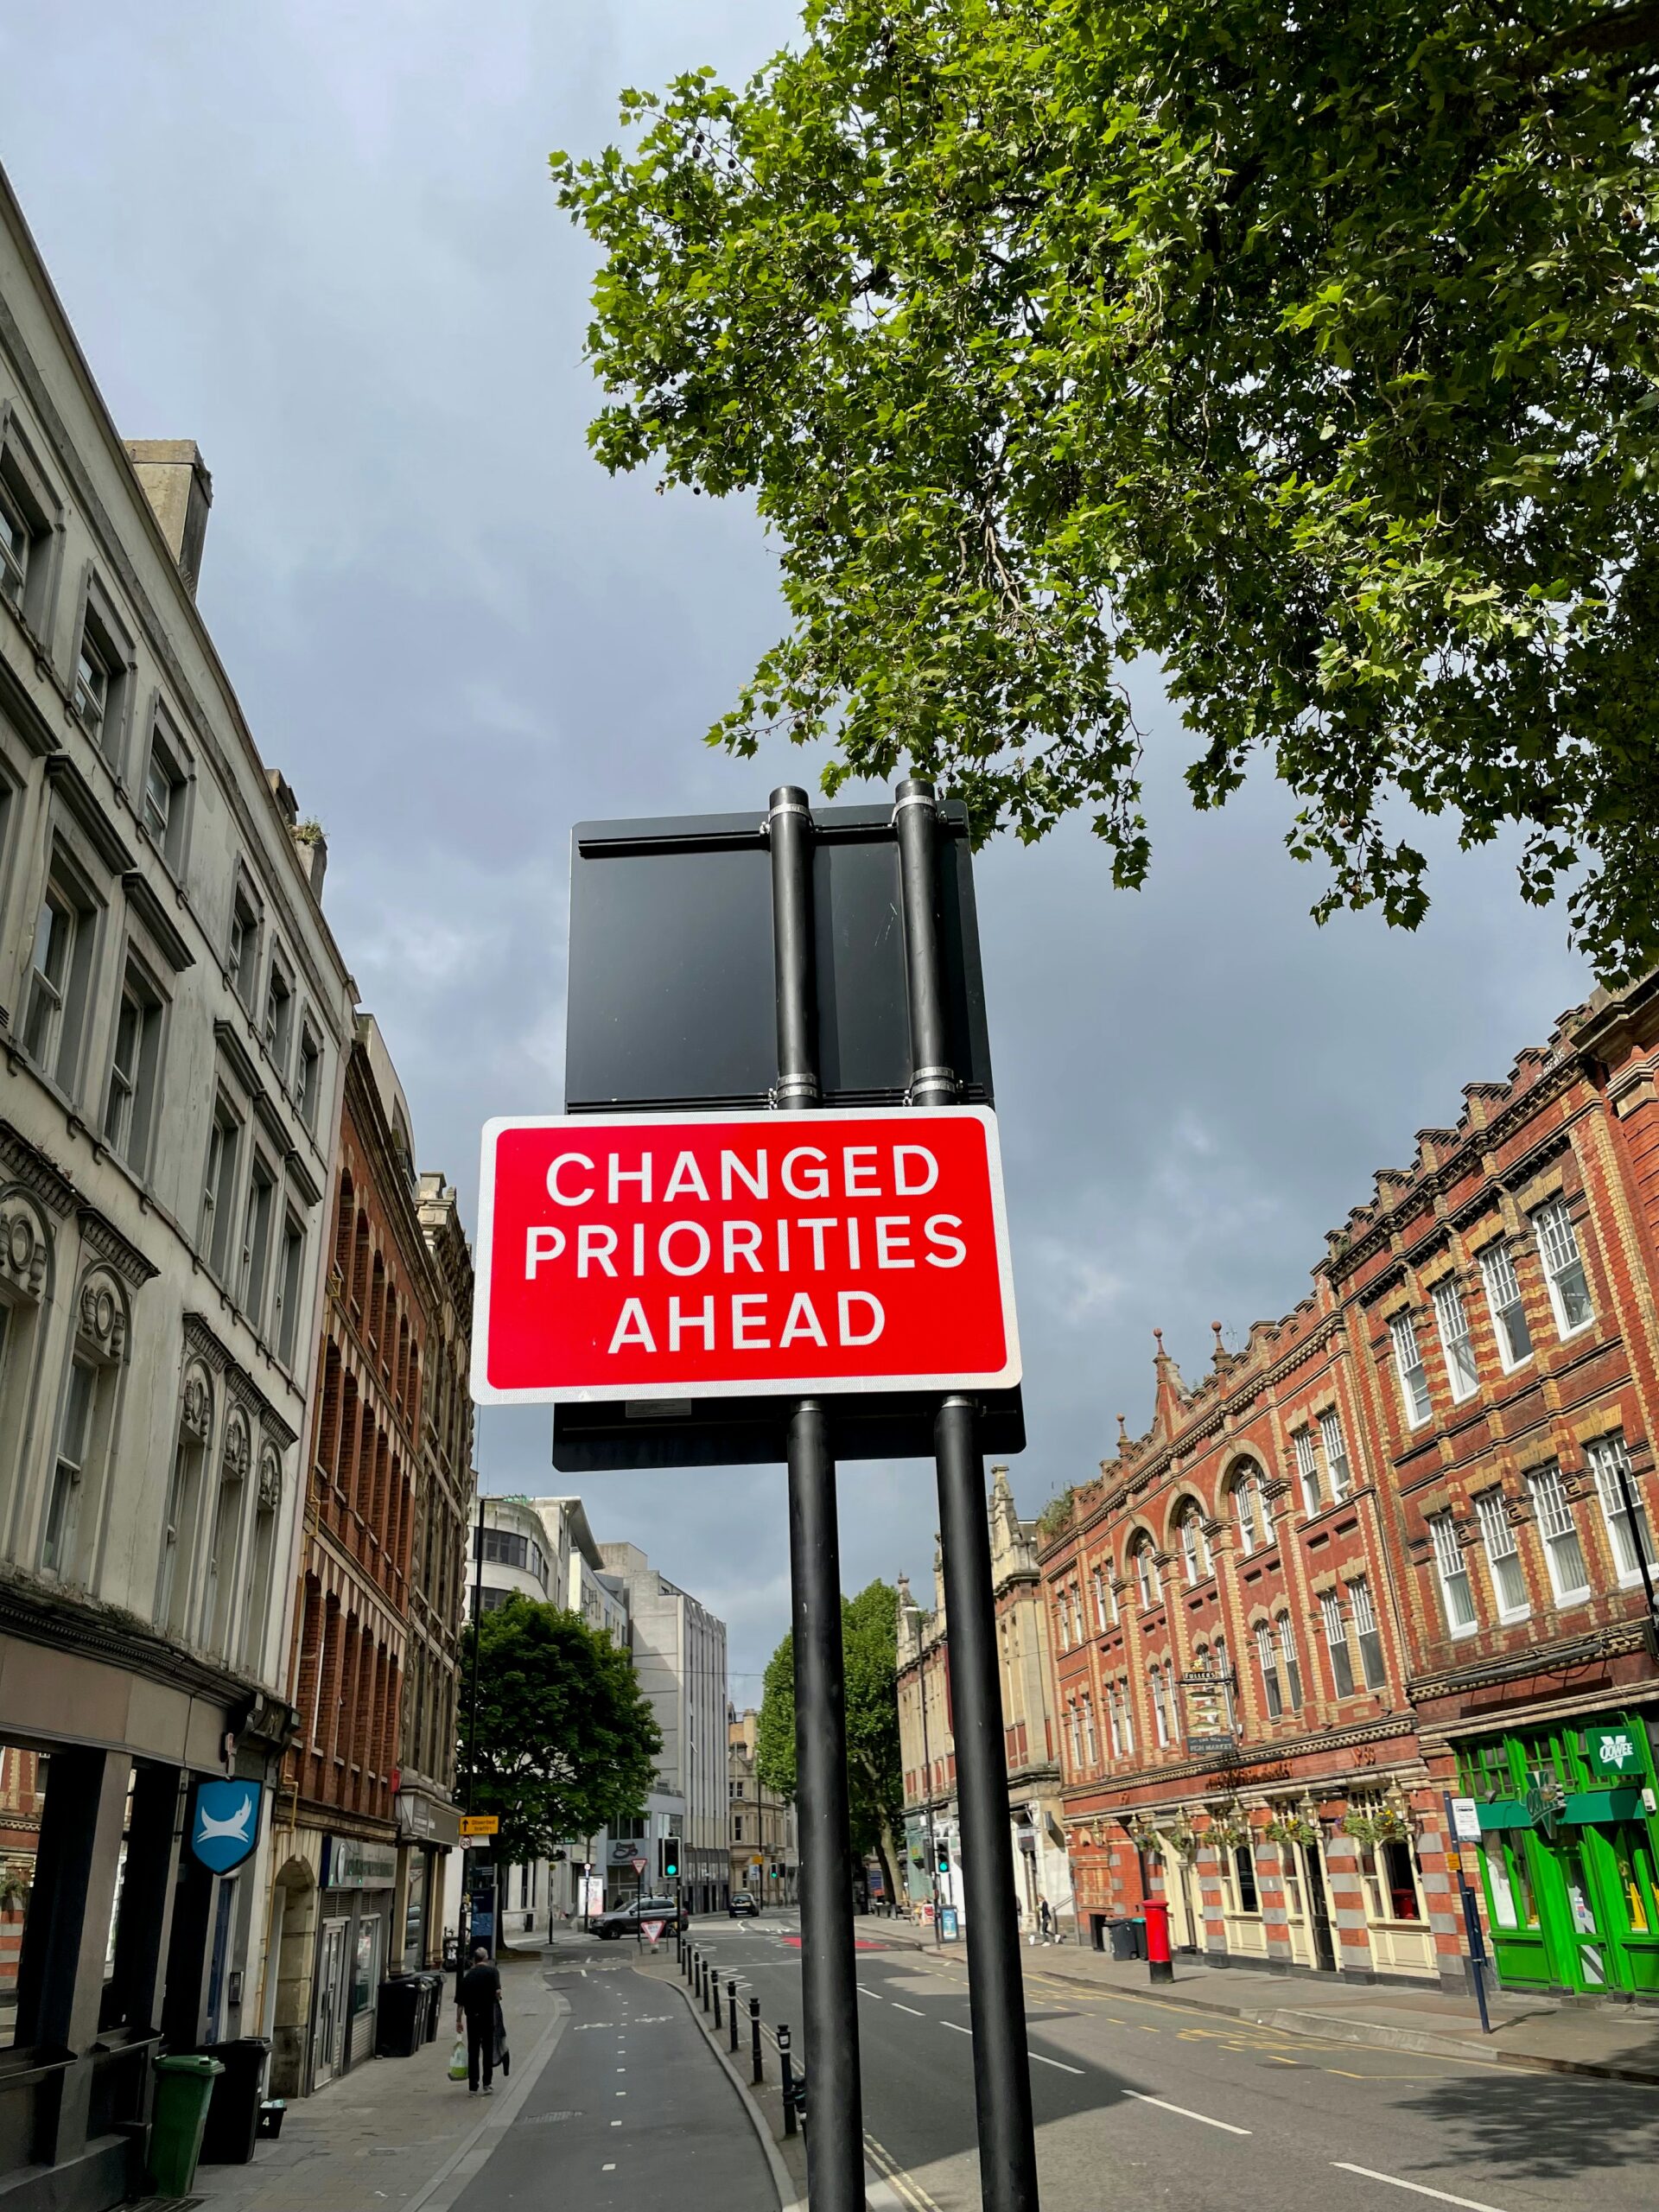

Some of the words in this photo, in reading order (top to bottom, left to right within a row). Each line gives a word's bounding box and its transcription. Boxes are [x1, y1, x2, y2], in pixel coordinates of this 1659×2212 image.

[547, 1146, 938, 1205] CHANGED
[526, 1215, 966, 1279] PRIORITIES
[608, 1292, 885, 1353] AHEAD
[262, 2117, 270, 2126] 4
